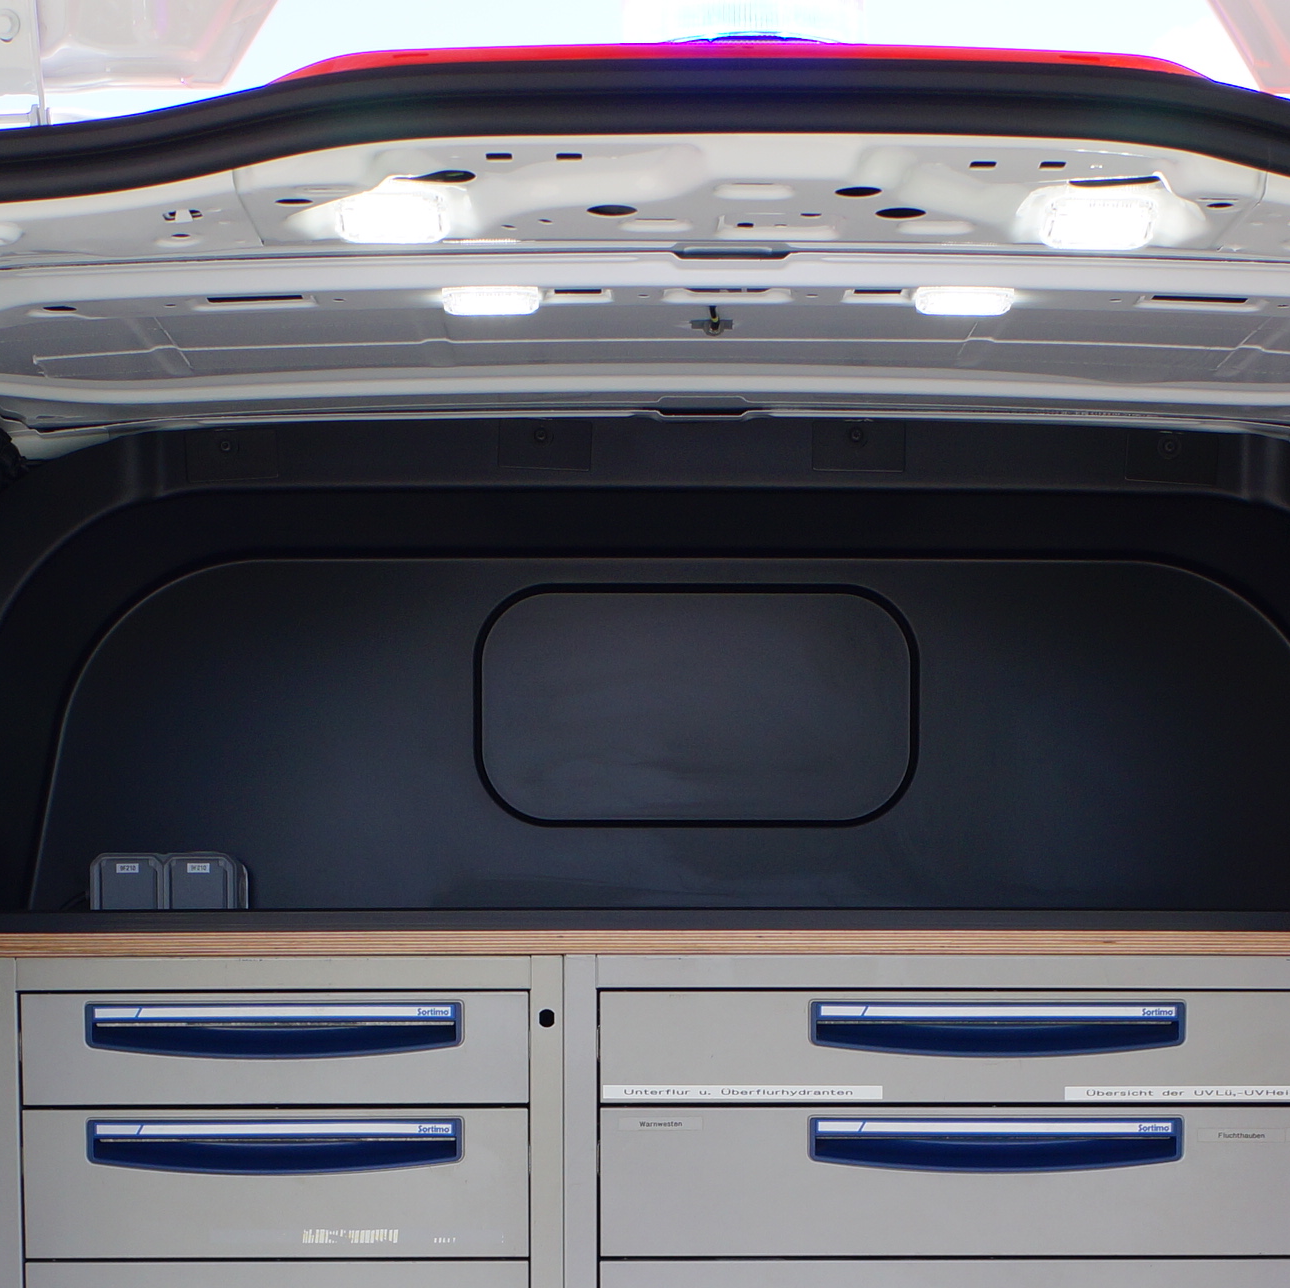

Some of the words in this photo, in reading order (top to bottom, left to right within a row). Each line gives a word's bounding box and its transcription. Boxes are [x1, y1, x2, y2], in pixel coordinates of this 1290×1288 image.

[417, 1007, 450, 1016] Sortimo
[1141, 1007, 1174, 1016] Sortimo
[623, 1088, 691, 1096] Unterflur
[721, 1087, 854, 1097] Überflurhydranten
[1086, 1088, 1154, 1097] Übersicht
[1162, 1089, 1185, 1097] der
[417, 1124, 450, 1133] Sortimo
[639, 1120, 683, 1128] Warnwesten
[1138, 1123, 1170, 1132] Sortimo
[1217, 1131, 1266, 1140] Fluchthauben
